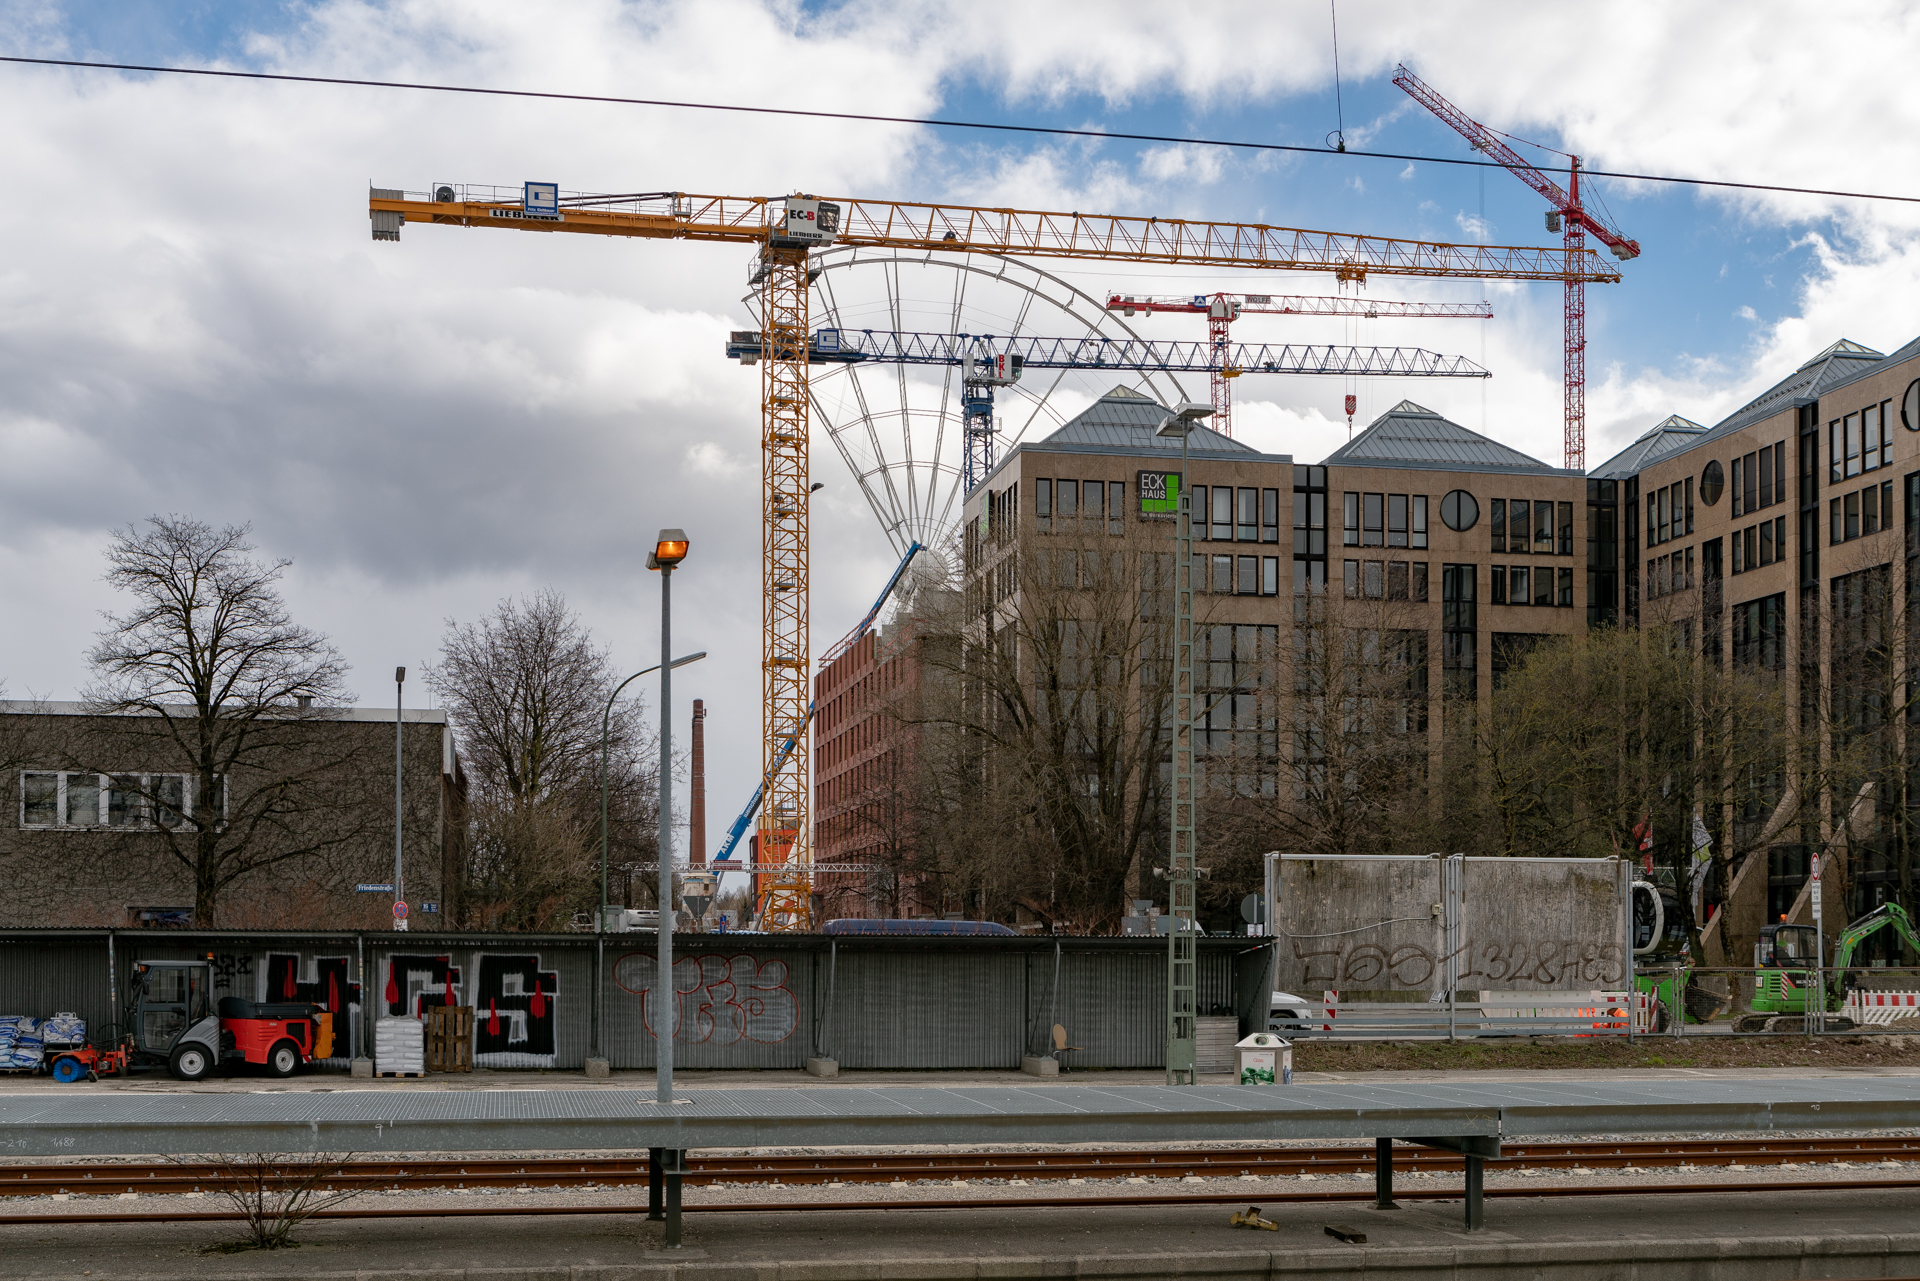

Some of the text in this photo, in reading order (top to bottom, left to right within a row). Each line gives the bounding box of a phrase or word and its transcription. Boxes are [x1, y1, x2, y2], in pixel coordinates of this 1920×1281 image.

[790, 209, 815, 221] EC-B
[789, 231, 823, 239] LIEBHERR
[1141, 473, 1165, 489] ECK
[1141, 489, 1166, 499] HAUS
[720, 834, 735, 855] AKM
